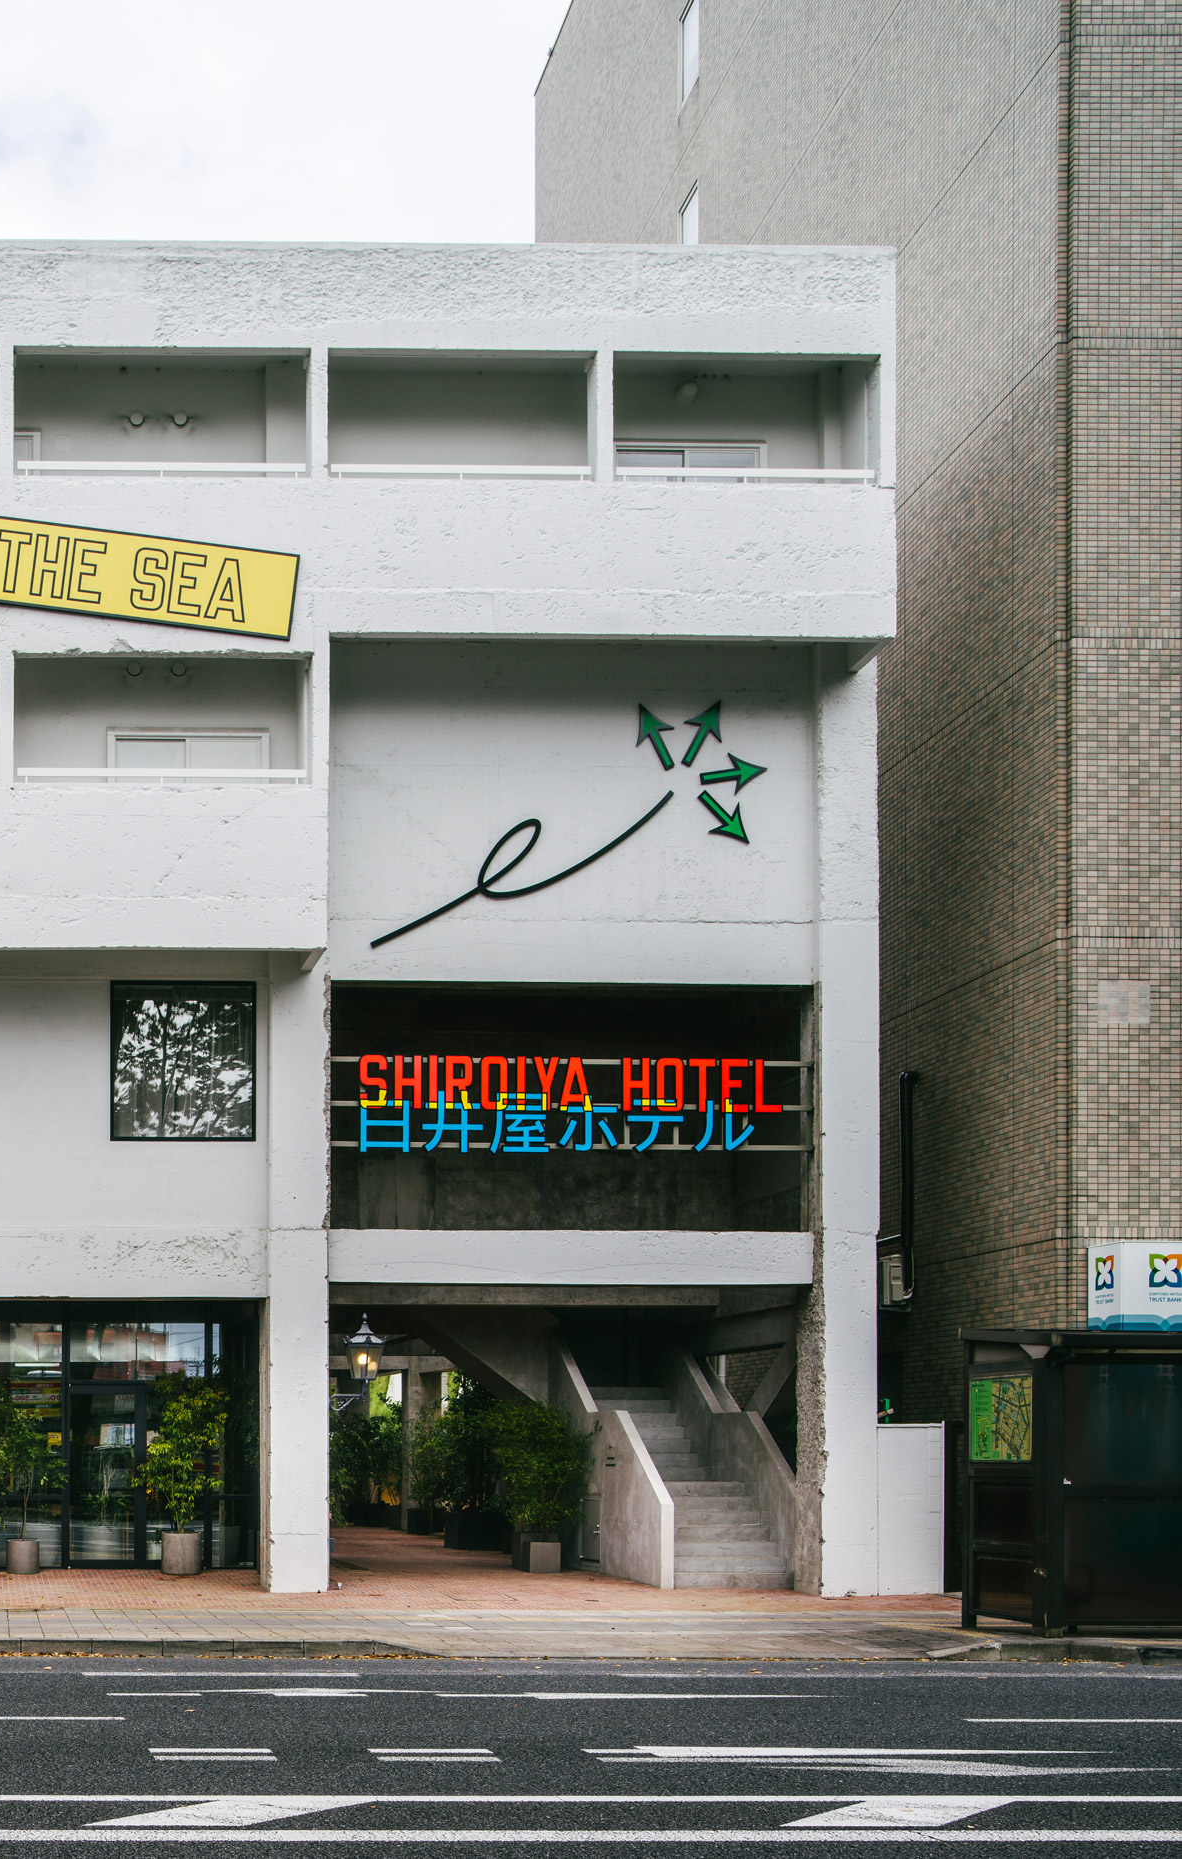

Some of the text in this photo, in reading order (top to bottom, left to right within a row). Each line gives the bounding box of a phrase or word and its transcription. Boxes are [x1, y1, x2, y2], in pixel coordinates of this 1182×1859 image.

[129, 547, 246, 624] SEA
[359, 1054, 783, 1113] SHIROIYA HOTEL
[359, 1089, 756, 1154] 白井屋ホテル
